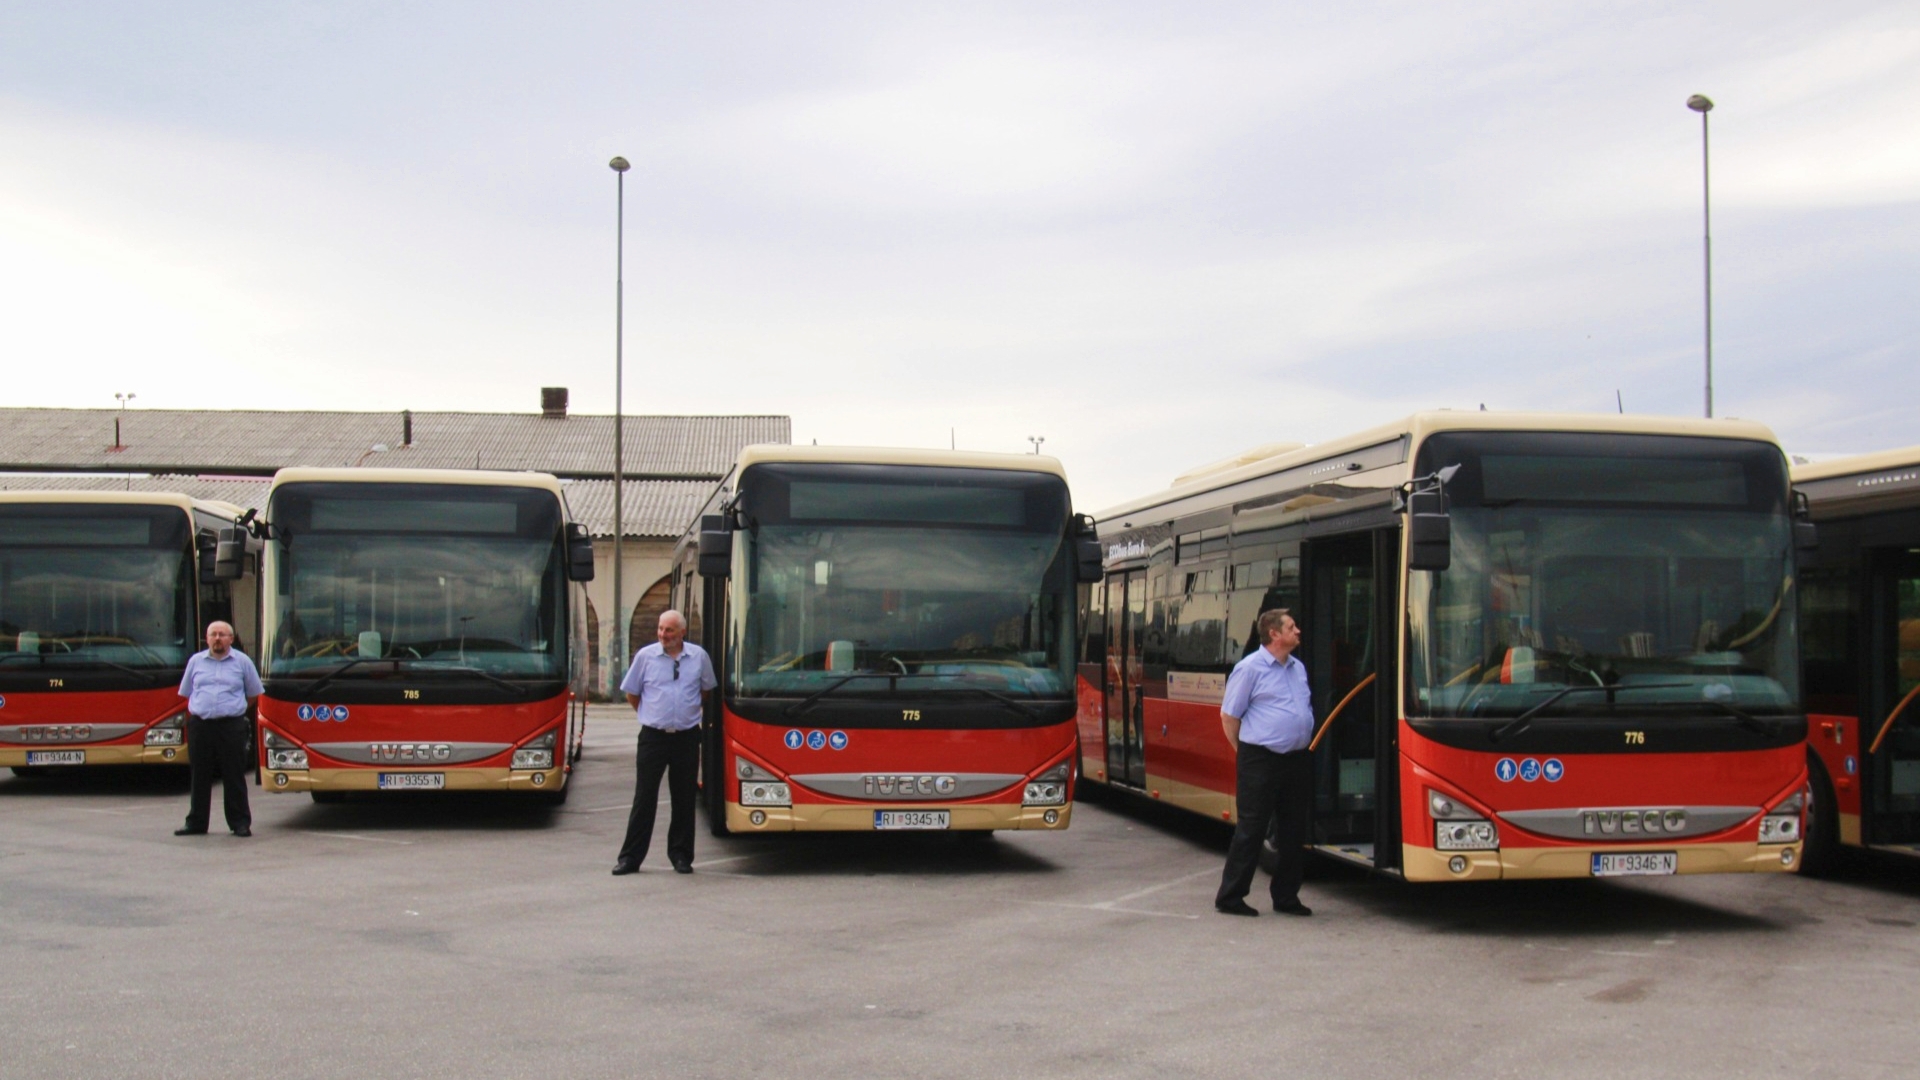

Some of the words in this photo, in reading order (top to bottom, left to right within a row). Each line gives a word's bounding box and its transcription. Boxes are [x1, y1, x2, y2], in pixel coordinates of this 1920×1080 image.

[49, 679, 63, 687] 774
[404, 690, 419, 699] 785
[903, 710, 920, 720] 775
[20, 726, 91, 740] IVECO
[1625, 732, 1645, 744] 776
[370, 744, 450, 760] IVECO
[33, 754, 43, 762] RI
[386, 776, 397, 785] RI
[865, 775, 955, 795] IVECO
[883, 814, 895, 825] RI
[1584, 810, 1686, 834] IVECO
[1602, 857, 1615, 871] RI
